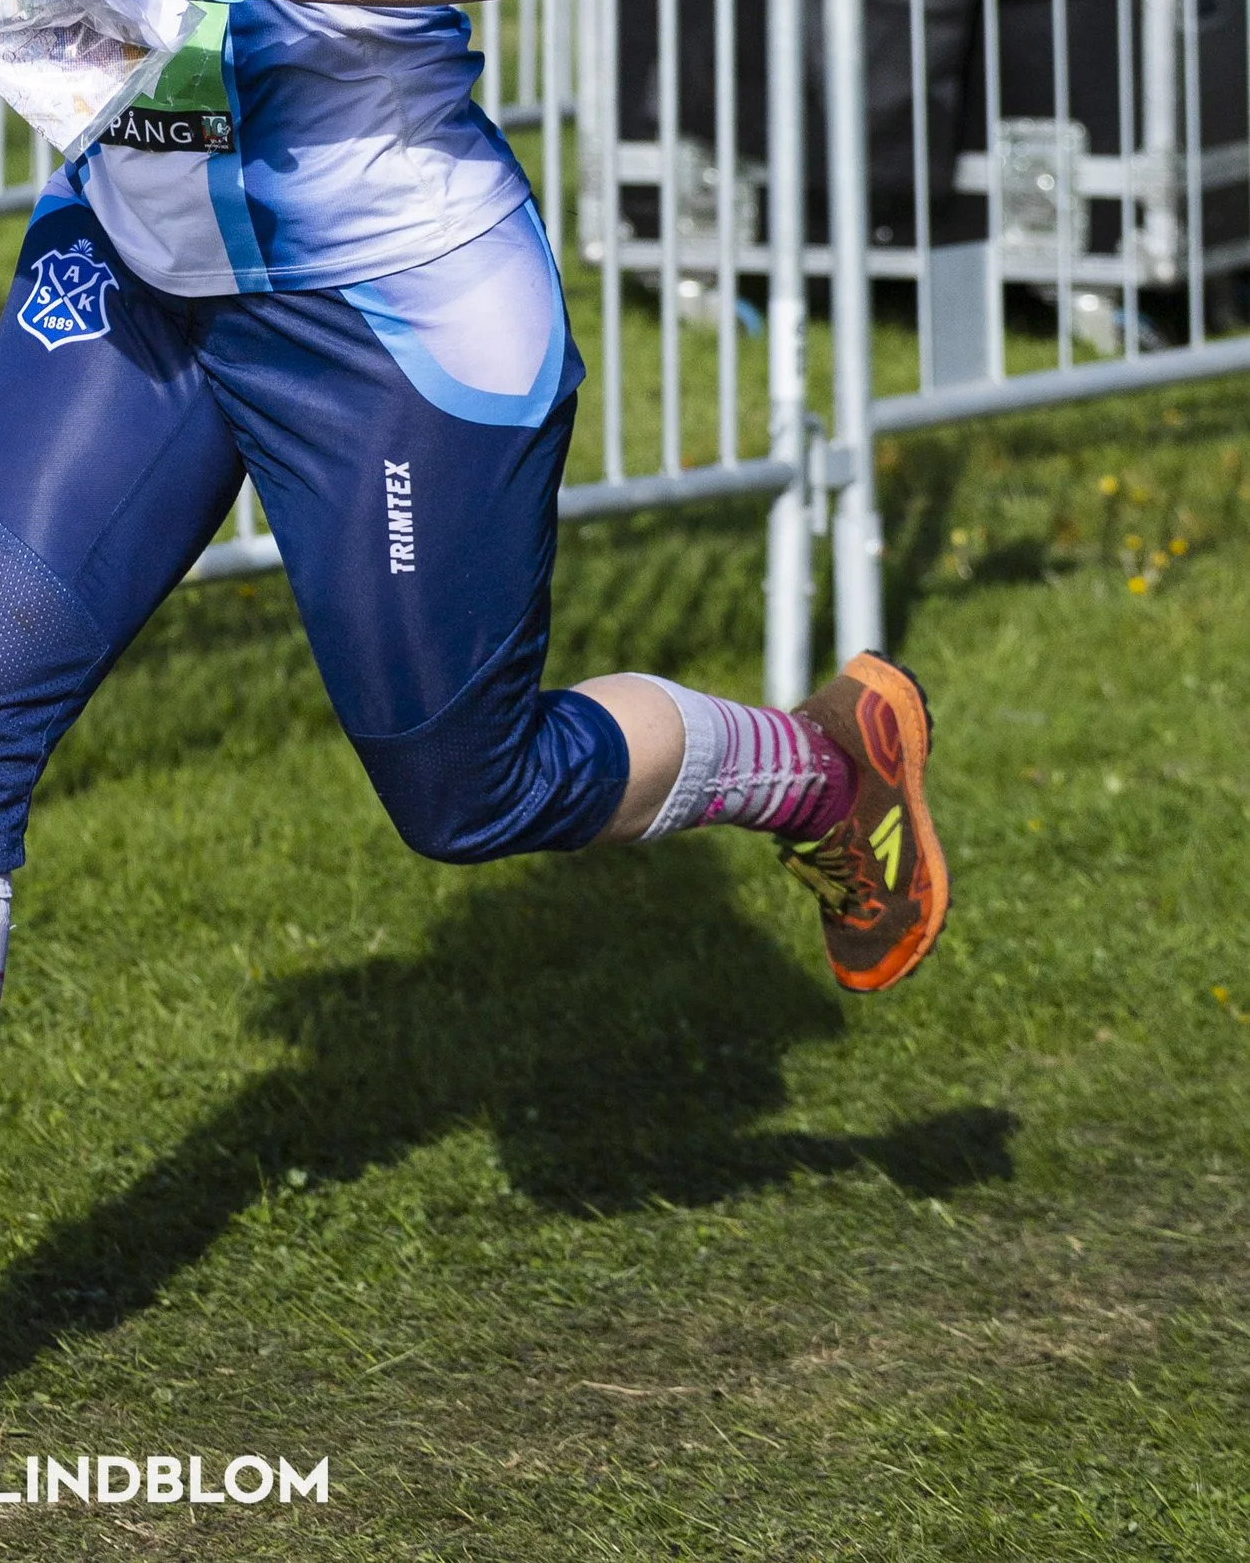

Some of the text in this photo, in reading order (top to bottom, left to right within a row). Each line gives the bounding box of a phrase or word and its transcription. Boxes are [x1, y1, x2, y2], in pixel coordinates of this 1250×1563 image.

[62, 265, 80, 283] A
[43, 316, 74, 331] 1889
[384, 459, 415, 575] TRIMTEX
